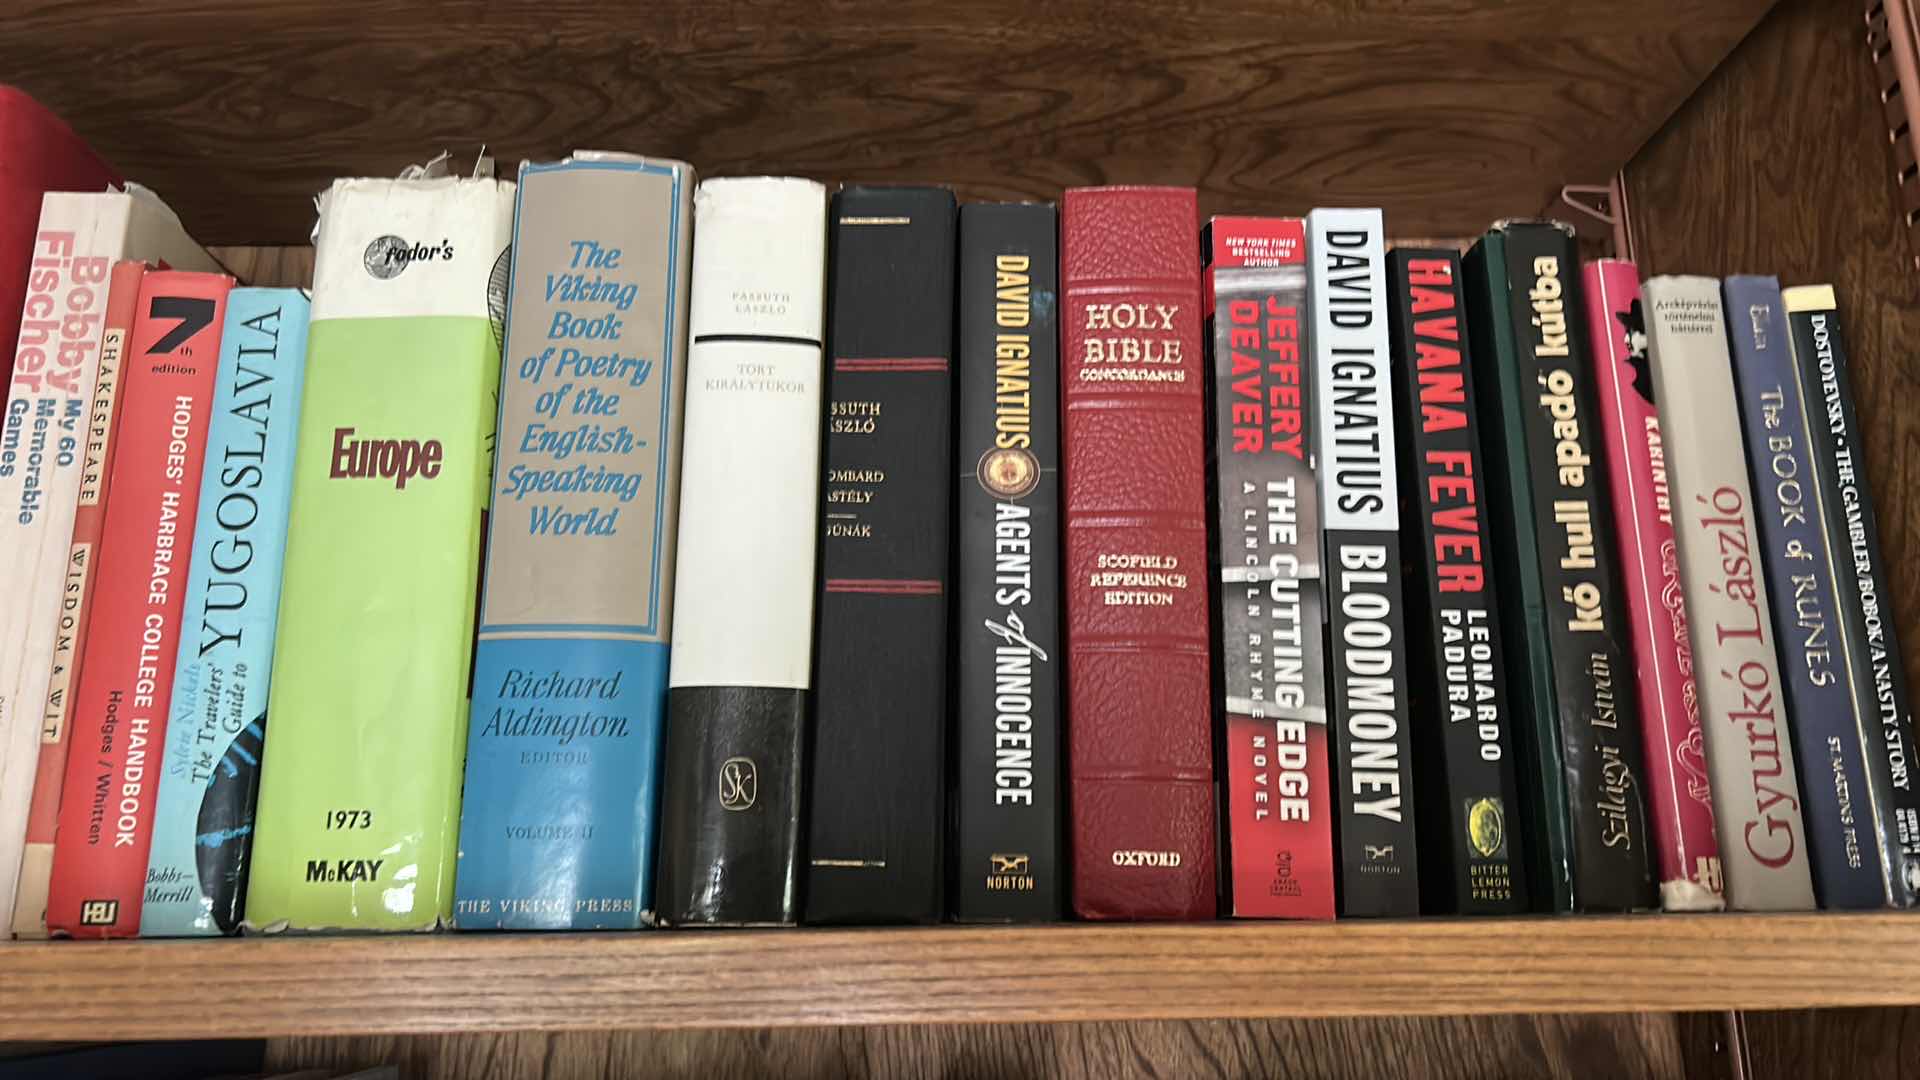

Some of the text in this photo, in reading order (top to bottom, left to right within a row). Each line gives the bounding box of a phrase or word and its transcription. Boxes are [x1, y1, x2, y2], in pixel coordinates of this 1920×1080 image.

[570, 241, 622, 269] The
[1225, 237, 1296, 248] NEW YORK TIMES
[1232, 247, 1291, 258] BESTSELLING
[1243, 258, 1279, 268] AUTHOR
[14, 231, 75, 393] Fischer
[545, 274, 638, 309] Viking
[1084, 305, 1178, 330] HOLY
[47, 256, 109, 394] Bobby
[547, 311, 623, 340] Book
[996, 255, 1030, 449] DAVID IGNATIUS
[1084, 338, 1183, 364] BIBLE
[151, 363, 196, 376] edition
[519, 349, 653, 386] of Poetry
[1229, 299, 1264, 453] DEAVER
[1266, 296, 1303, 460] JEFFERY
[1326, 231, 1384, 515] DAVID IGNATIUS
[1811, 313, 1846, 437] DOSTOYEVSKY
[57, 399, 82, 466] My 60
[82, 334, 118, 500] SHAKESPEARE
[535, 387, 619, 418] of the
[1407, 259, 1486, 593] HAVANA FEVER
[0, 399, 29, 477] Games
[19, 399, 56, 525] Memorable
[329, 427, 442, 489] Europe
[519, 424, 647, 459] English-
[1529, 256, 1604, 632] kő hull apadó kútba
[1836, 446, 1853, 488] THE
[199, 306, 281, 658] YUGOSLAVIA
[501, 465, 642, 500] Speaking
[1644, 416, 1673, 526] KARINTHY
[528, 506, 619, 536] World
[1266, 476, 1297, 545] THE
[1761, 384, 1836, 687] The BOOK of RUNES
[1090, 573, 1187, 588] REFERENCE
[1097, 554, 1178, 570] SCOFIELD
[57, 549, 85, 652] WISDOM
[115, 396, 192, 848] HODGES' HARBRACE COLLEGE HANDBOOK
[1104, 591, 1174, 606] EDITION
[985, 503, 1048, 805] AGENTS of INNOCENCE
[1243, 482, 1269, 821] A LINCOLN RHYME NOVEL
[1269, 554, 1305, 710] CUTTING
[497, 669, 624, 700] Richard
[1340, 544, 1402, 823] BLOODMONEY
[1440, 609, 1471, 723] PADURA
[1466, 609, 1501, 761] LEONARDO
[1696, 485, 1798, 869] Gyurkó László
[1873, 658, 1898, 731] NASTY
[44, 689, 63, 738] WIT
[101, 690, 122, 753] Hodges
[222, 663, 248, 735] Guide to
[481, 709, 630, 744] Aldington
[192, 753, 213, 784] The
[520, 751, 590, 765] EDITOR
[1276, 721, 1311, 823] EDGE
[1885, 728, 1911, 791] STORY
[87, 773, 112, 845] Whitten
[326, 810, 371, 829] 1973
[505, 825, 574, 840] VOLUME
[306, 859, 384, 881] McKAY
[986, 875, 1033, 890] NORTON
[1112, 851, 1181, 867] OXFORD
[1470, 864, 1509, 876] BITTER
[1471, 877, 1510, 888] LEMON
[457, 899, 633, 913] THE VIKING PRESS
[1472, 889, 1511, 900] PRESS
